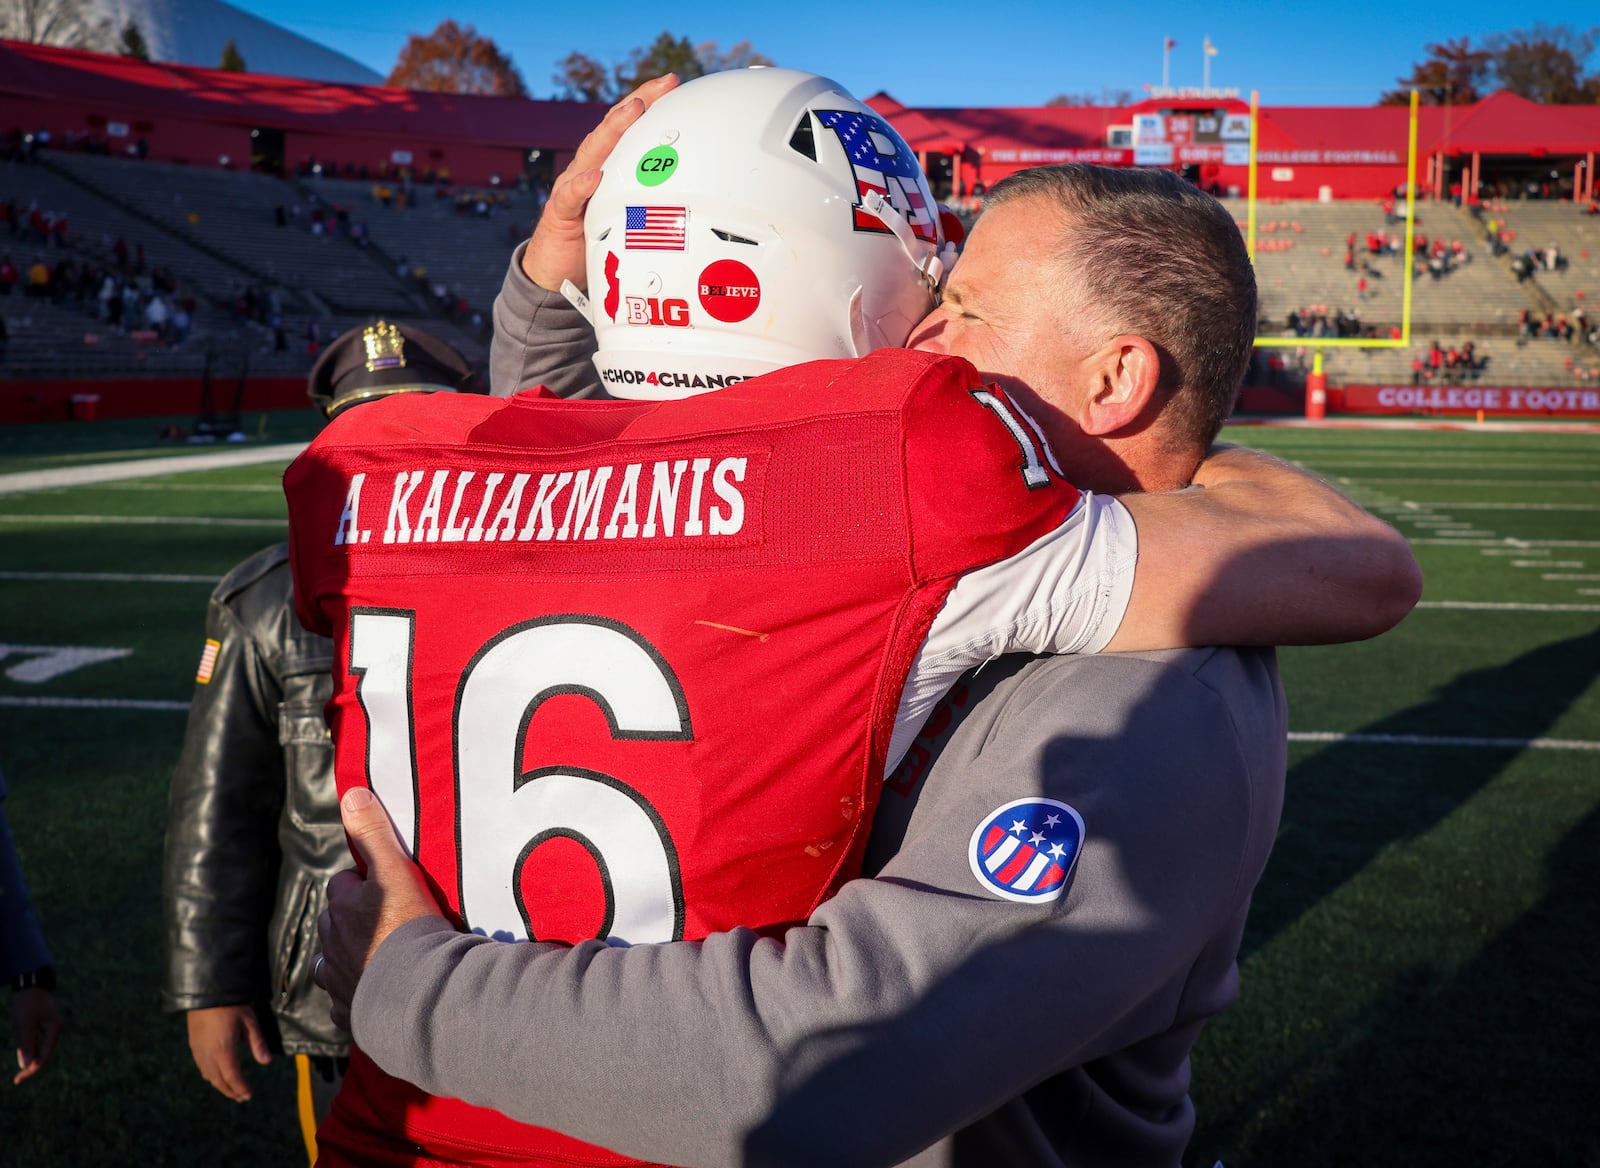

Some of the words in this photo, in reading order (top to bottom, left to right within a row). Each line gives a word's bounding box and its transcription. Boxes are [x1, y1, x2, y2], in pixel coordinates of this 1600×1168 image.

[640, 158, 675, 172] C2P
[991, 150, 1016, 161] THE
[1104, 151, 1122, 161] OF
[1324, 151, 1398, 163] FOOTBALL
[811, 109, 938, 245] R
[700, 285, 759, 298] BELIEVE
[602, 369, 758, 389] #CHOP4CHANG
[1377, 387, 1500, 408] COLLEGE
[1508, 389, 1600, 410] FOOTB
[335, 473, 371, 546] A.
[383, 457, 748, 545] KALIAKMANIS
[349, 606, 695, 946] 16
